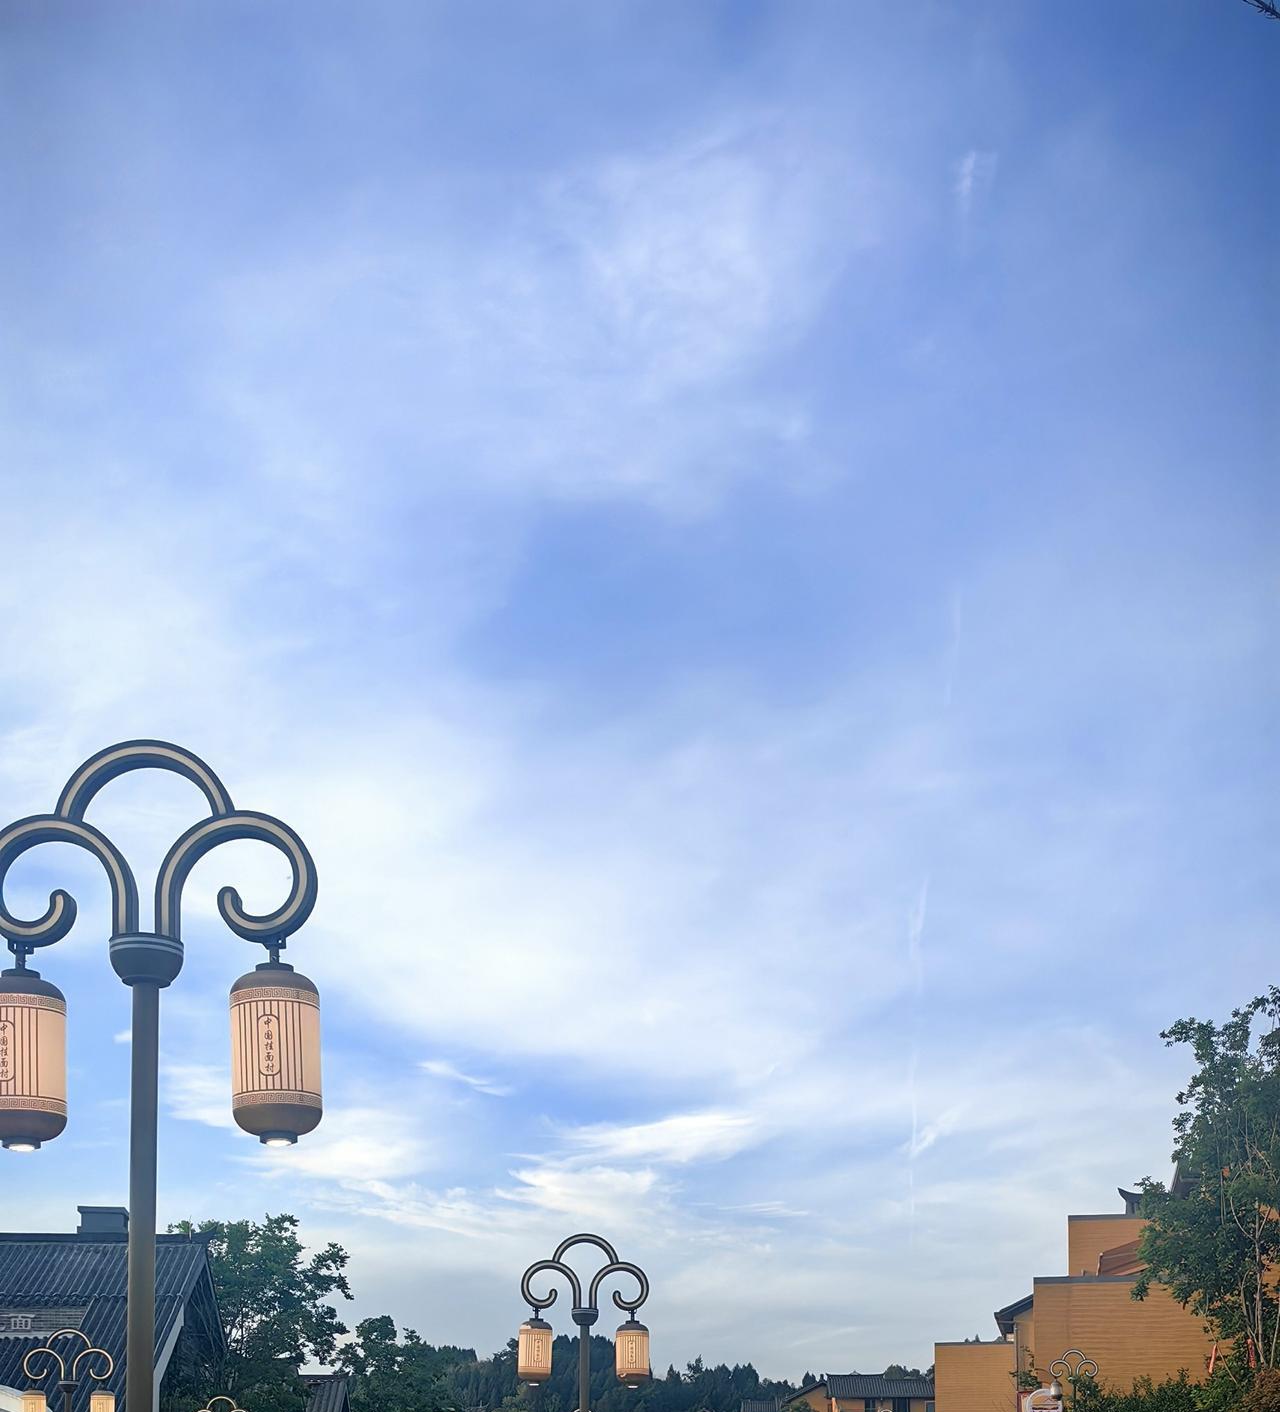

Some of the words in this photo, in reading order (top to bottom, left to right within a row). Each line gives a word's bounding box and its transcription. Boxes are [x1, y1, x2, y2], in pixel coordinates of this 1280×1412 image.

[264, 1016, 274, 1073] 中国挂面村
